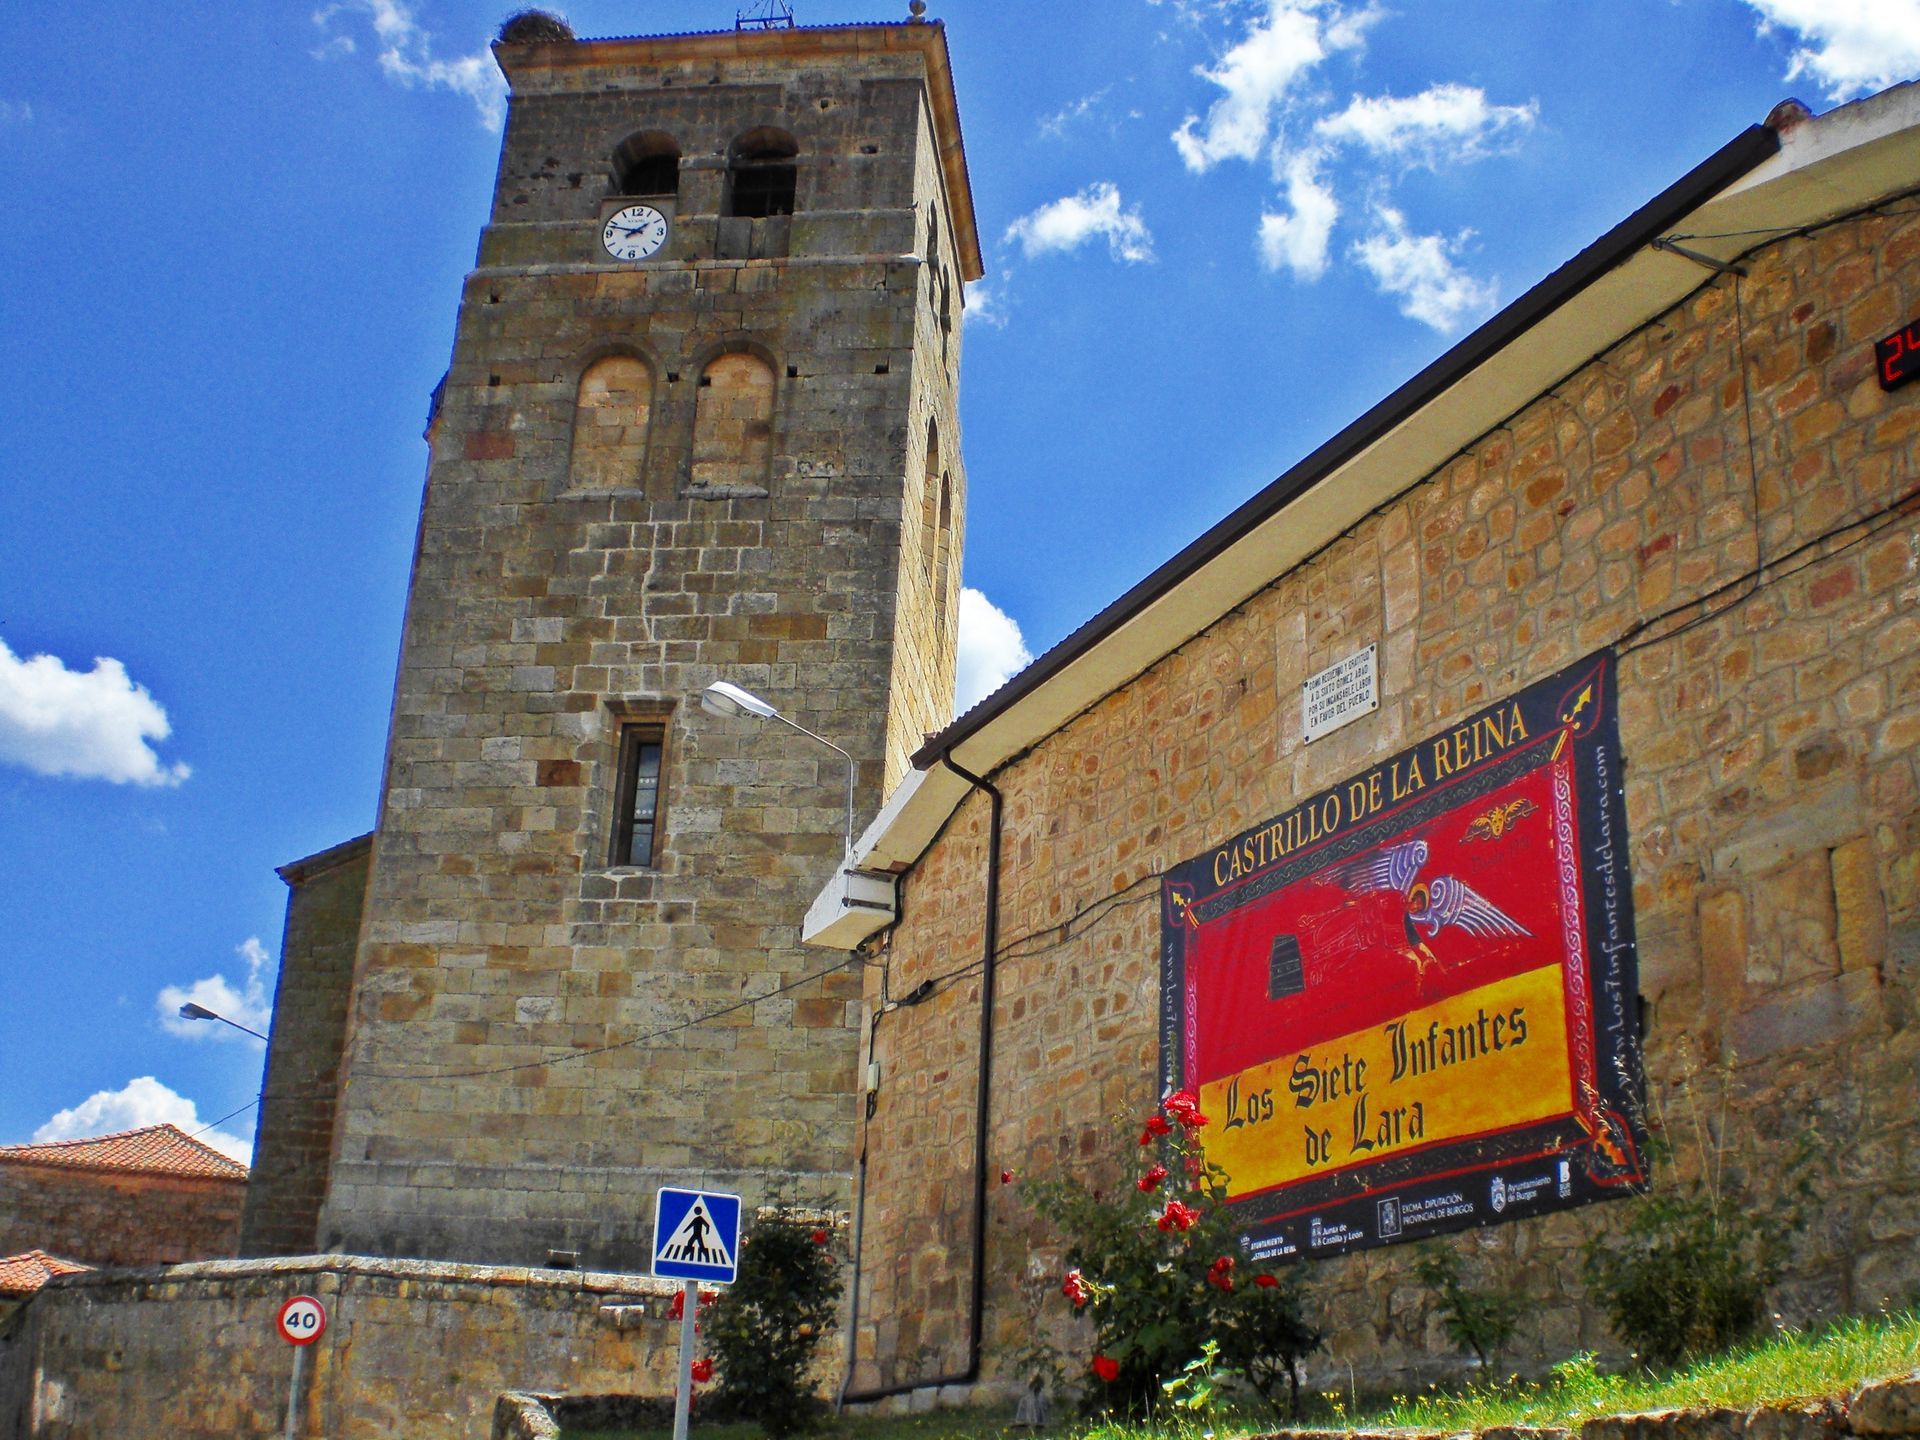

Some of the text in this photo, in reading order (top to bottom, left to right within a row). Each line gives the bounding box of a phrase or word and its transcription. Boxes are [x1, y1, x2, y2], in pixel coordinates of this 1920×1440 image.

[631, 207, 644, 217] 12
[605, 229, 614, 239] 9
[656, 227, 664, 236] 3
[627, 249, 636, 259] 6
[1309, 679, 1321, 691] COMO
[1321, 665, 1344, 682] RECUERDO
[1348, 650, 1370, 670] GRATITUD
[1355, 664, 1368, 678] ABAD
[1308, 675, 1371, 716] POR SU INCANSABLE LABOR
[1310, 689, 1370, 728] EN FAVOR DEL PUEBLO
[1213, 701, 1530, 887] CASTRILLO DE LA REINA
[1222, 1006, 1529, 1133] Los Siete Infantes
[1304, 1092, 1425, 1167] de Lara
[1508, 1177, 1551, 1192] Ayuntamiento
[1516, 1190, 1537, 1201] Burgos
[1403, 1203, 1474, 1225] PROVINCIAL DE BURGOS
[286, 1312, 316, 1329] 40
